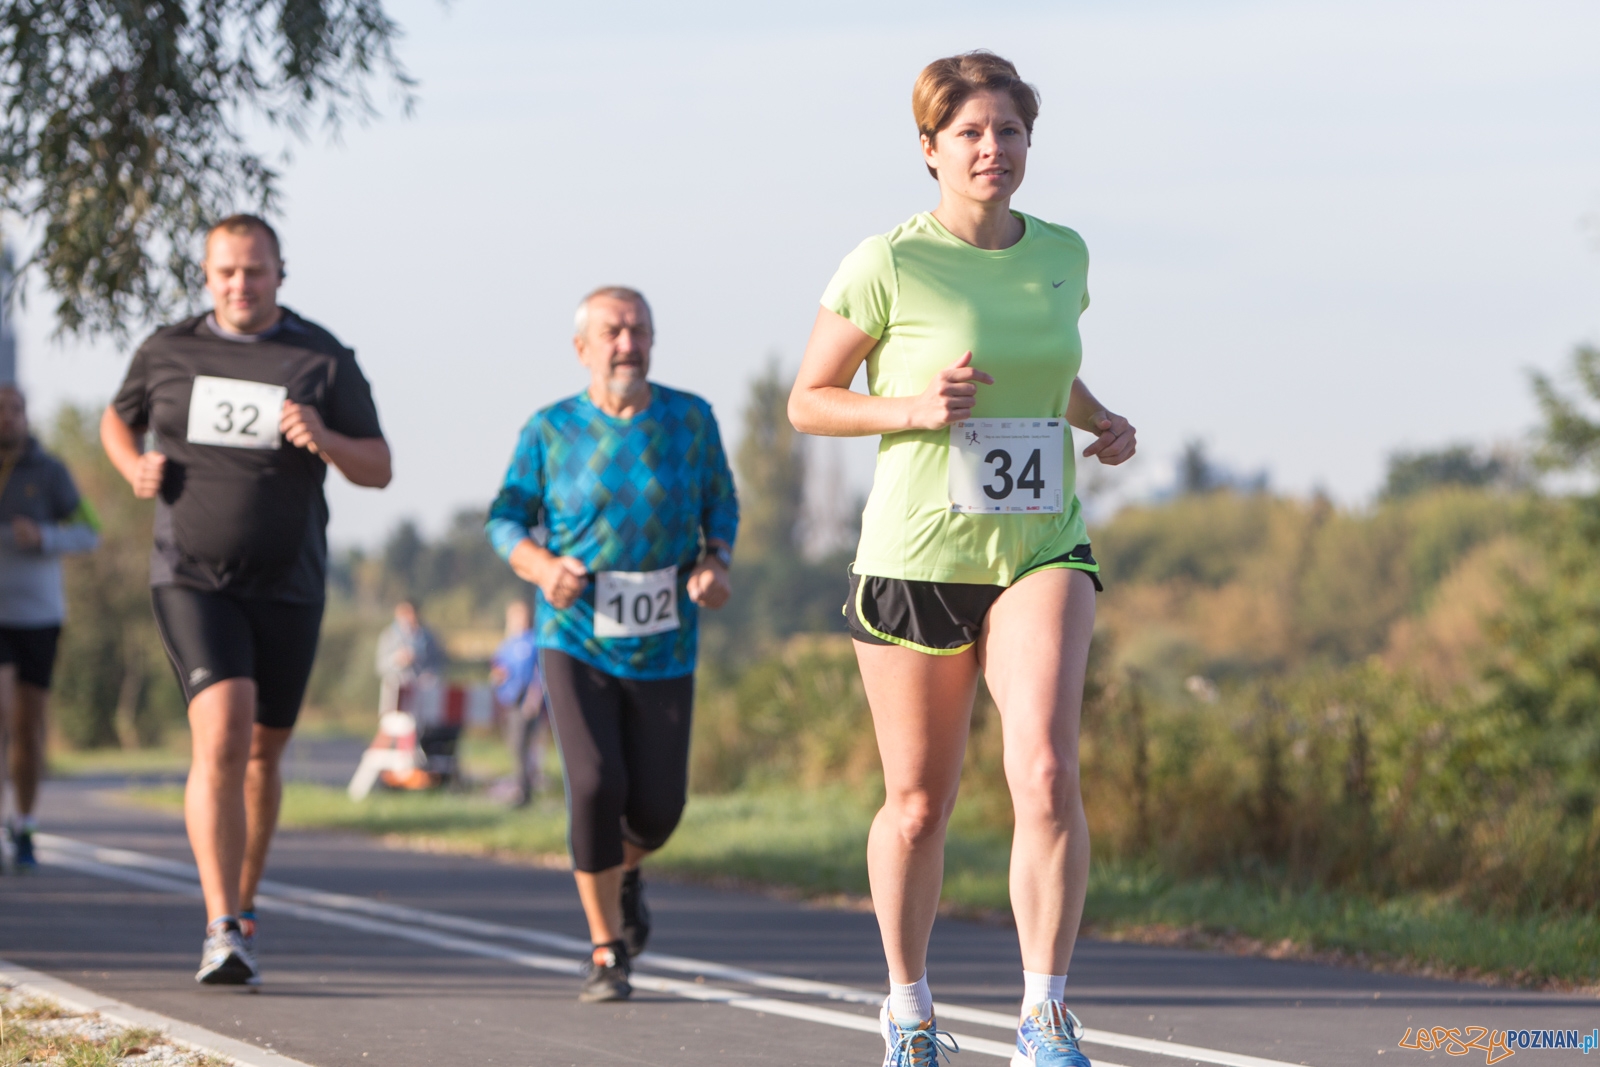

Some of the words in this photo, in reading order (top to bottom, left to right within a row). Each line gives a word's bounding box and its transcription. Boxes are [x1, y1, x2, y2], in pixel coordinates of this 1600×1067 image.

[214, 401, 260, 436] 32
[983, 448, 1045, 500] 34
[607, 587, 672, 626] 102
